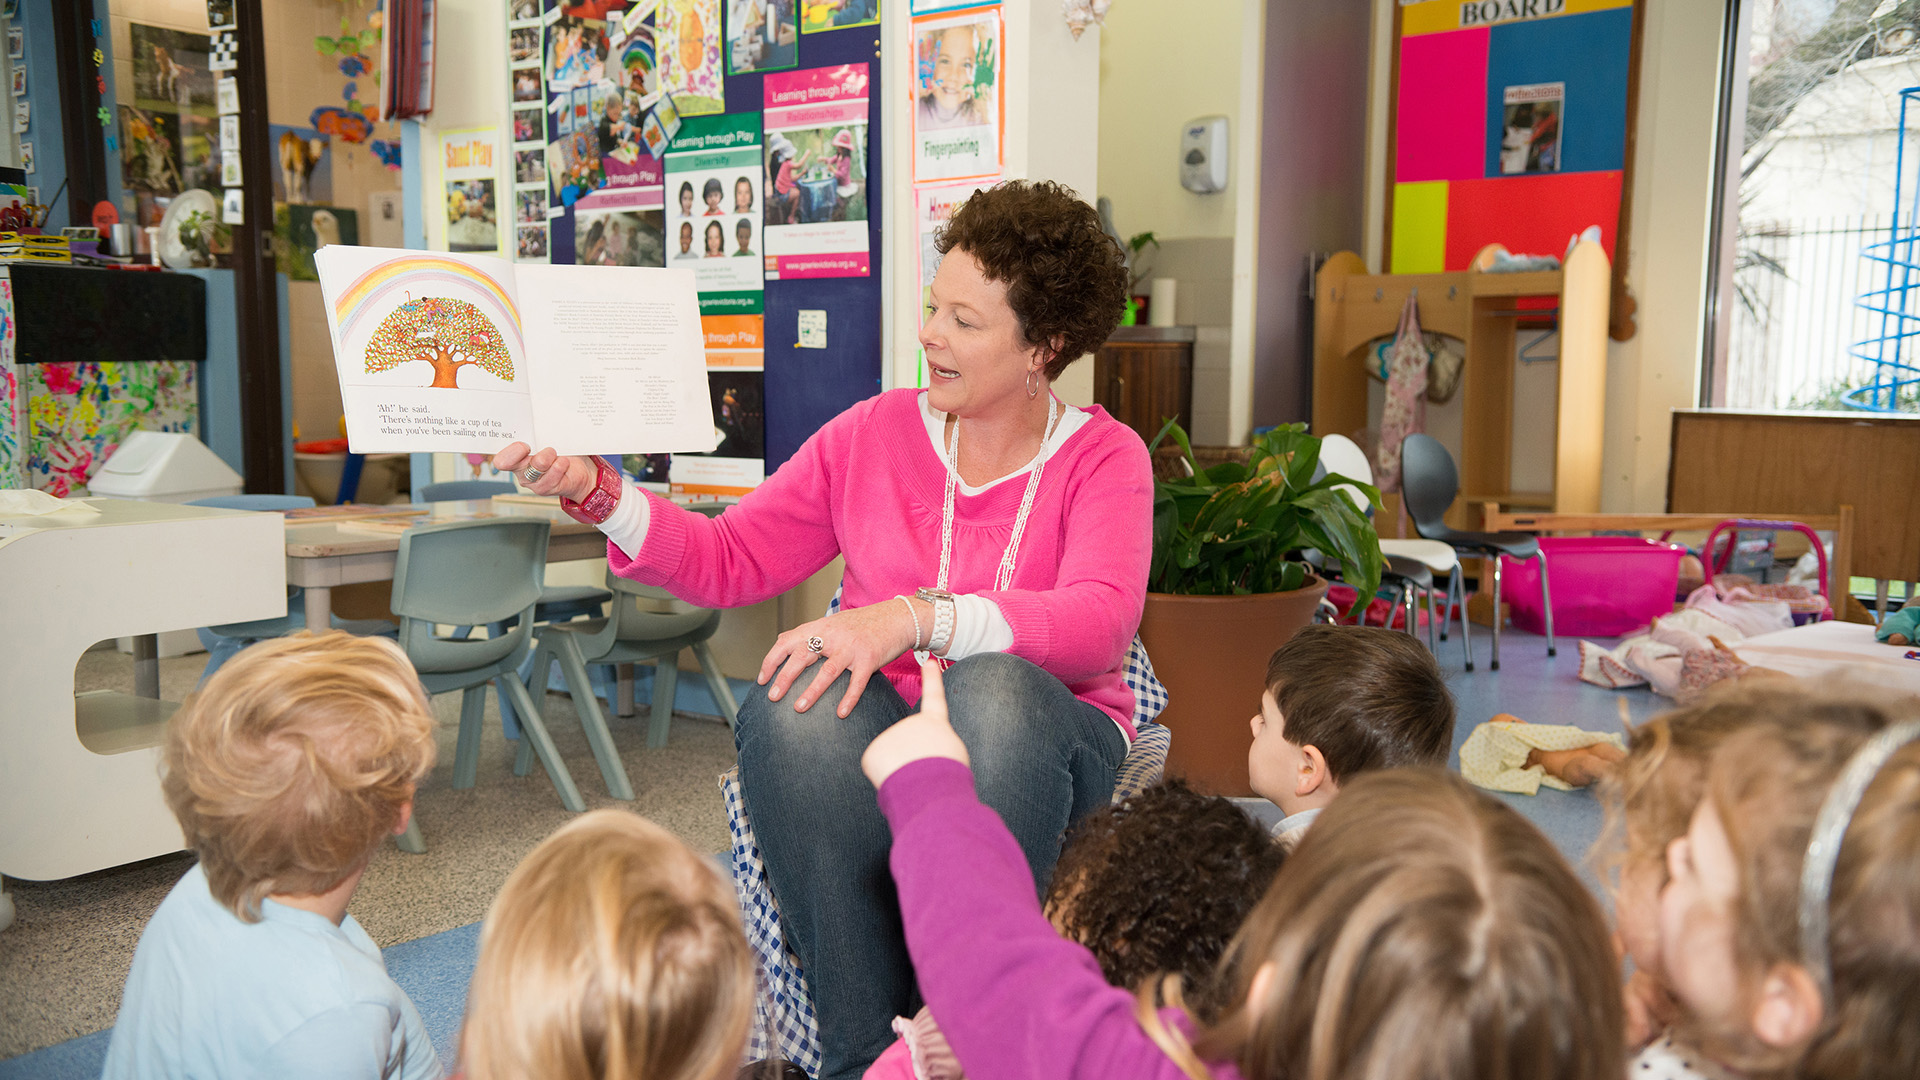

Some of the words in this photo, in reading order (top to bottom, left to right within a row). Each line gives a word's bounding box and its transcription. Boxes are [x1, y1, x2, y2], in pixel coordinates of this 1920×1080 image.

[1462, 0, 1563, 26] BOARD
[772, 89, 807, 103] Learning
[808, 84, 840, 100] through
[841, 82, 861, 97] Play
[786, 108, 844, 122] Relationships
[671, 136, 704, 149] Learning
[704, 132, 736, 146] through
[736, 130, 755, 144] Play
[446, 141, 470, 168] Sand
[472, 140, 493, 168] Play
[924, 138, 979, 160] Fingerpainting
[694, 155, 730, 167] Diversity
[611, 172, 639, 186] through
[639, 170, 657, 184] Play
[707, 332, 738, 346] through
[738, 331, 757, 345] Play
[398, 404, 409, 414] he
[412, 405, 430, 414] said.
[414, 416, 443, 426] nothing
[445, 416, 458, 425] like
[467, 419, 481, 428] cup
[482, 418, 490, 427] of
[491, 420, 502, 428] tea
[380, 426, 403, 435] when
[405, 426, 429, 436] you've
[432, 427, 451, 436] been
[453, 427, 477, 438] sailing
[478, 430, 487, 438] on
[489, 429, 499, 438] the
